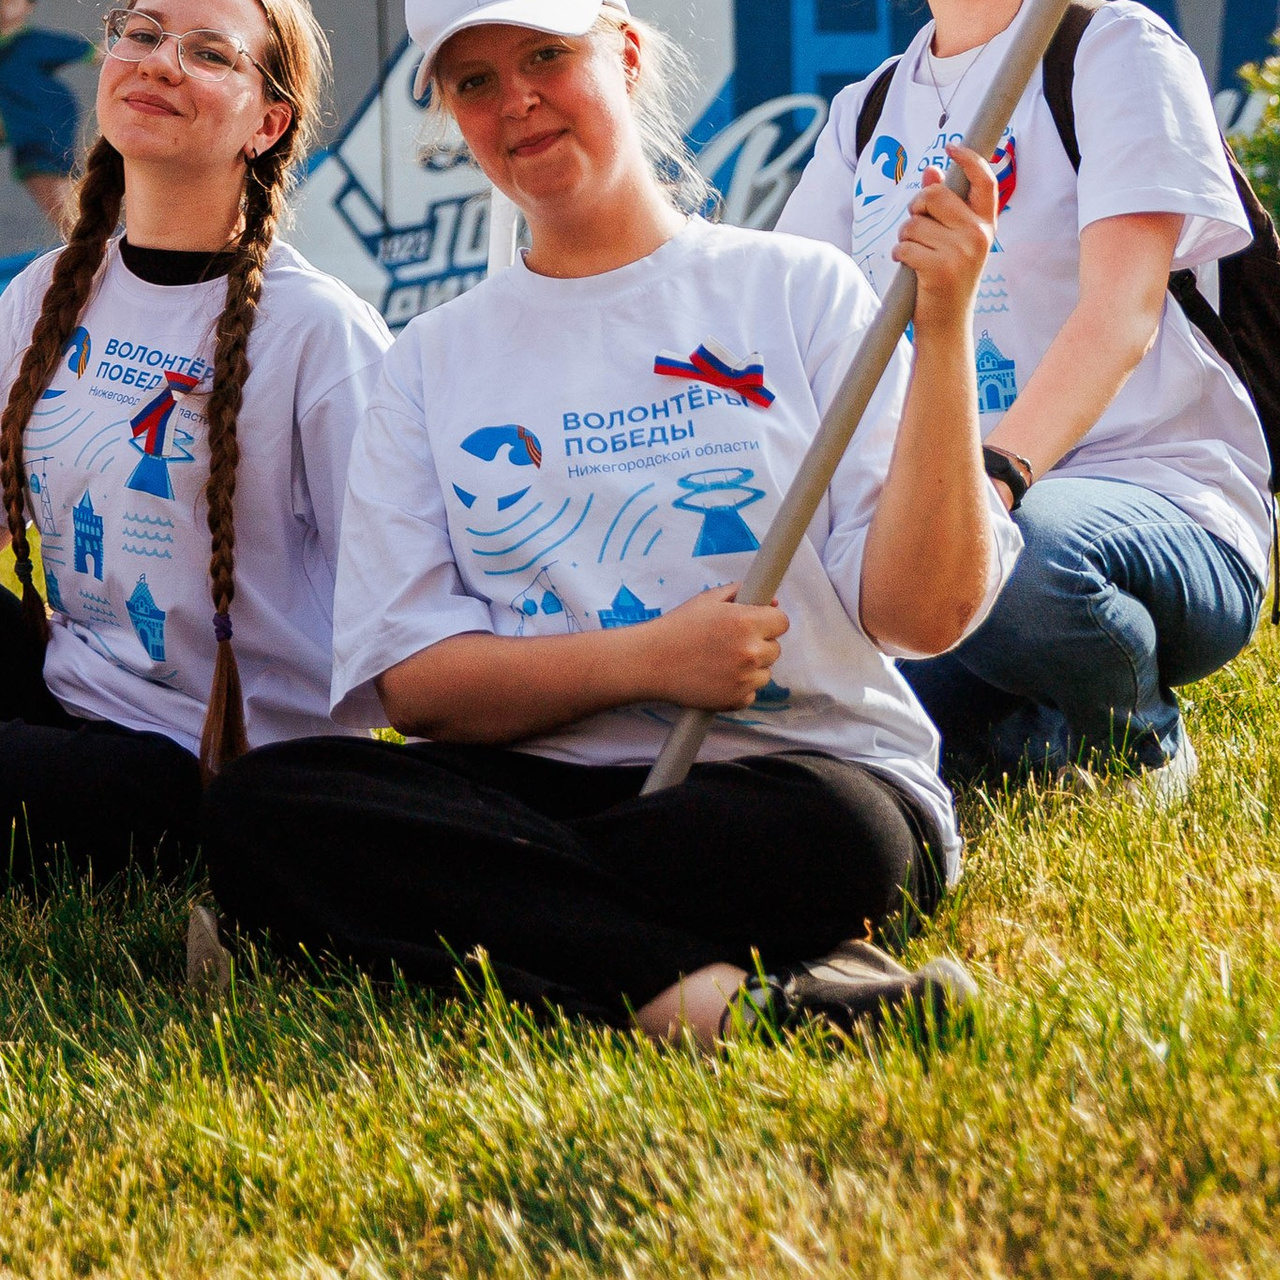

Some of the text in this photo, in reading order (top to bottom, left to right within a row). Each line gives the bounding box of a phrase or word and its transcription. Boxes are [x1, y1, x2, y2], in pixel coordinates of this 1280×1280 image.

[95, 360, 163, 392] ПОБЕД
[104, 338, 216, 382] ВОЛОНТЁР
[565, 419, 695, 457] ПОБЕДЫ
[567, 439, 761, 479] Нижегородской области
